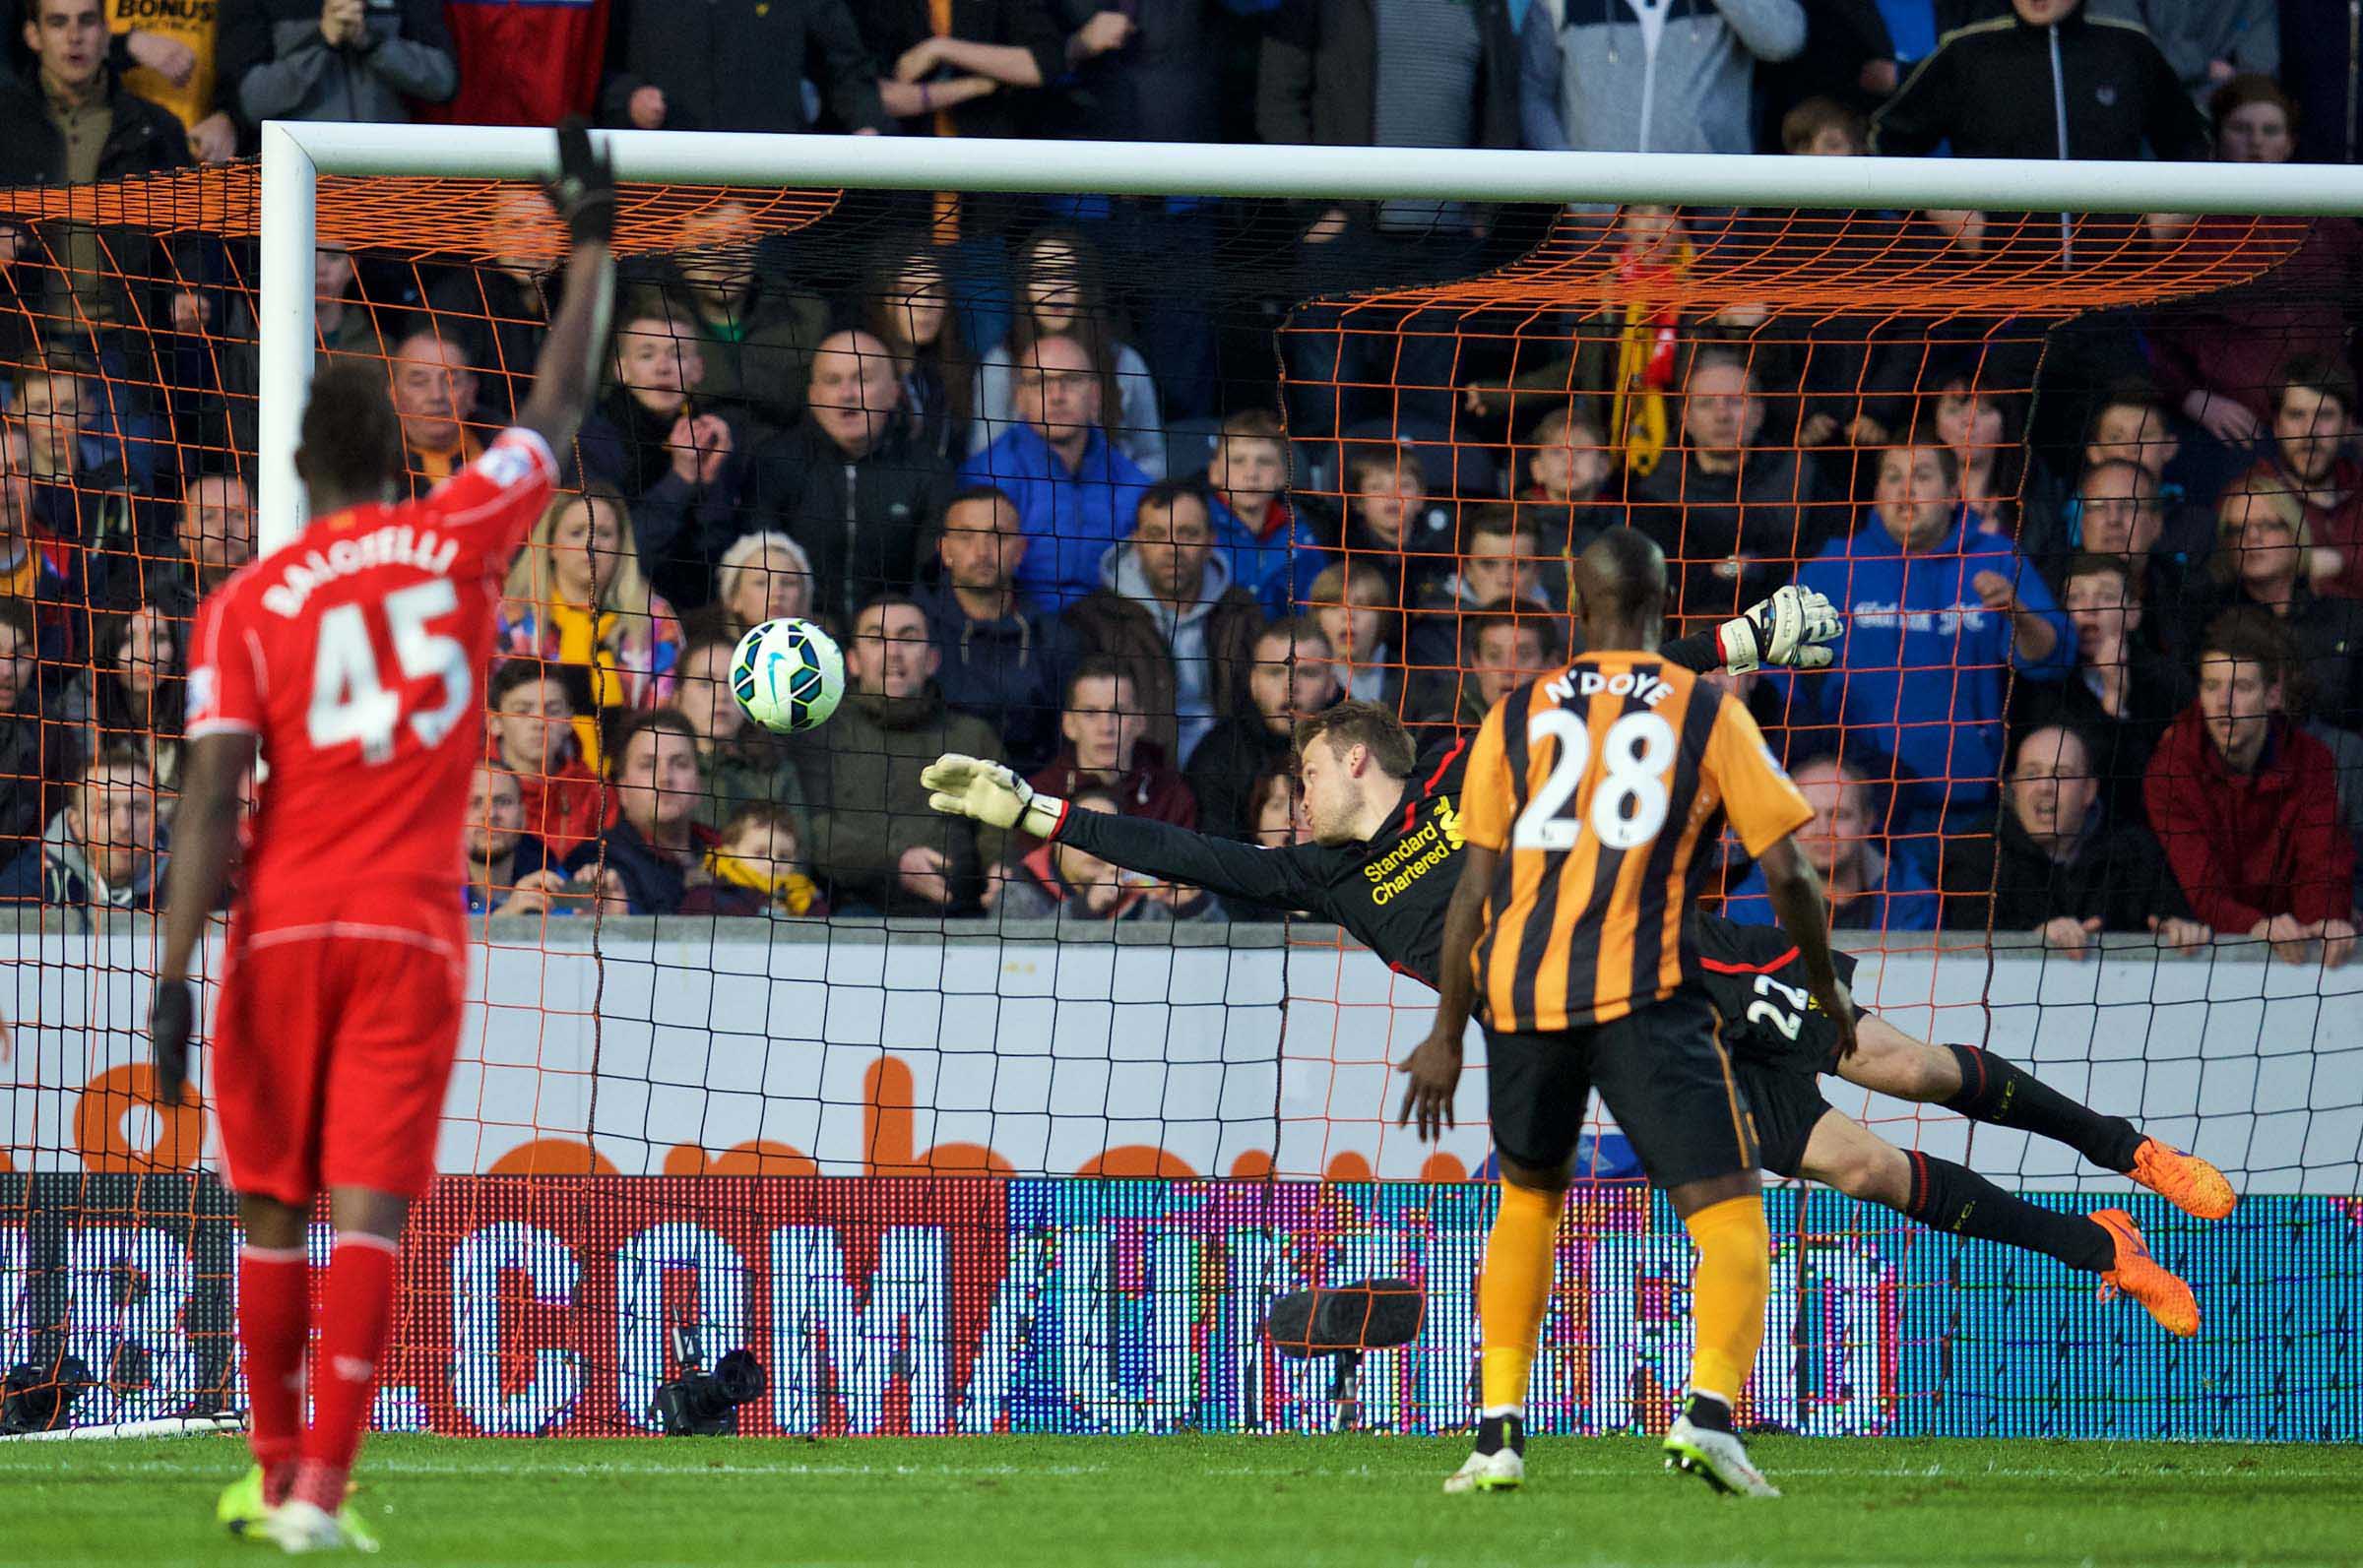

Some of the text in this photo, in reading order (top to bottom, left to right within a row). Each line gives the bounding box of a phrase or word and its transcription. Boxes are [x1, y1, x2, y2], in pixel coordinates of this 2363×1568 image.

[261, 525, 460, 619] BALOTELLI
[306, 577, 475, 766] 45
[1544, 669, 1676, 706] N'DOYE
[1512, 708, 1677, 851] 28
[1364, 820, 1438, 883] Standard
[1372, 840, 1450, 906] Chartered
[1747, 974, 1809, 1041] 22
